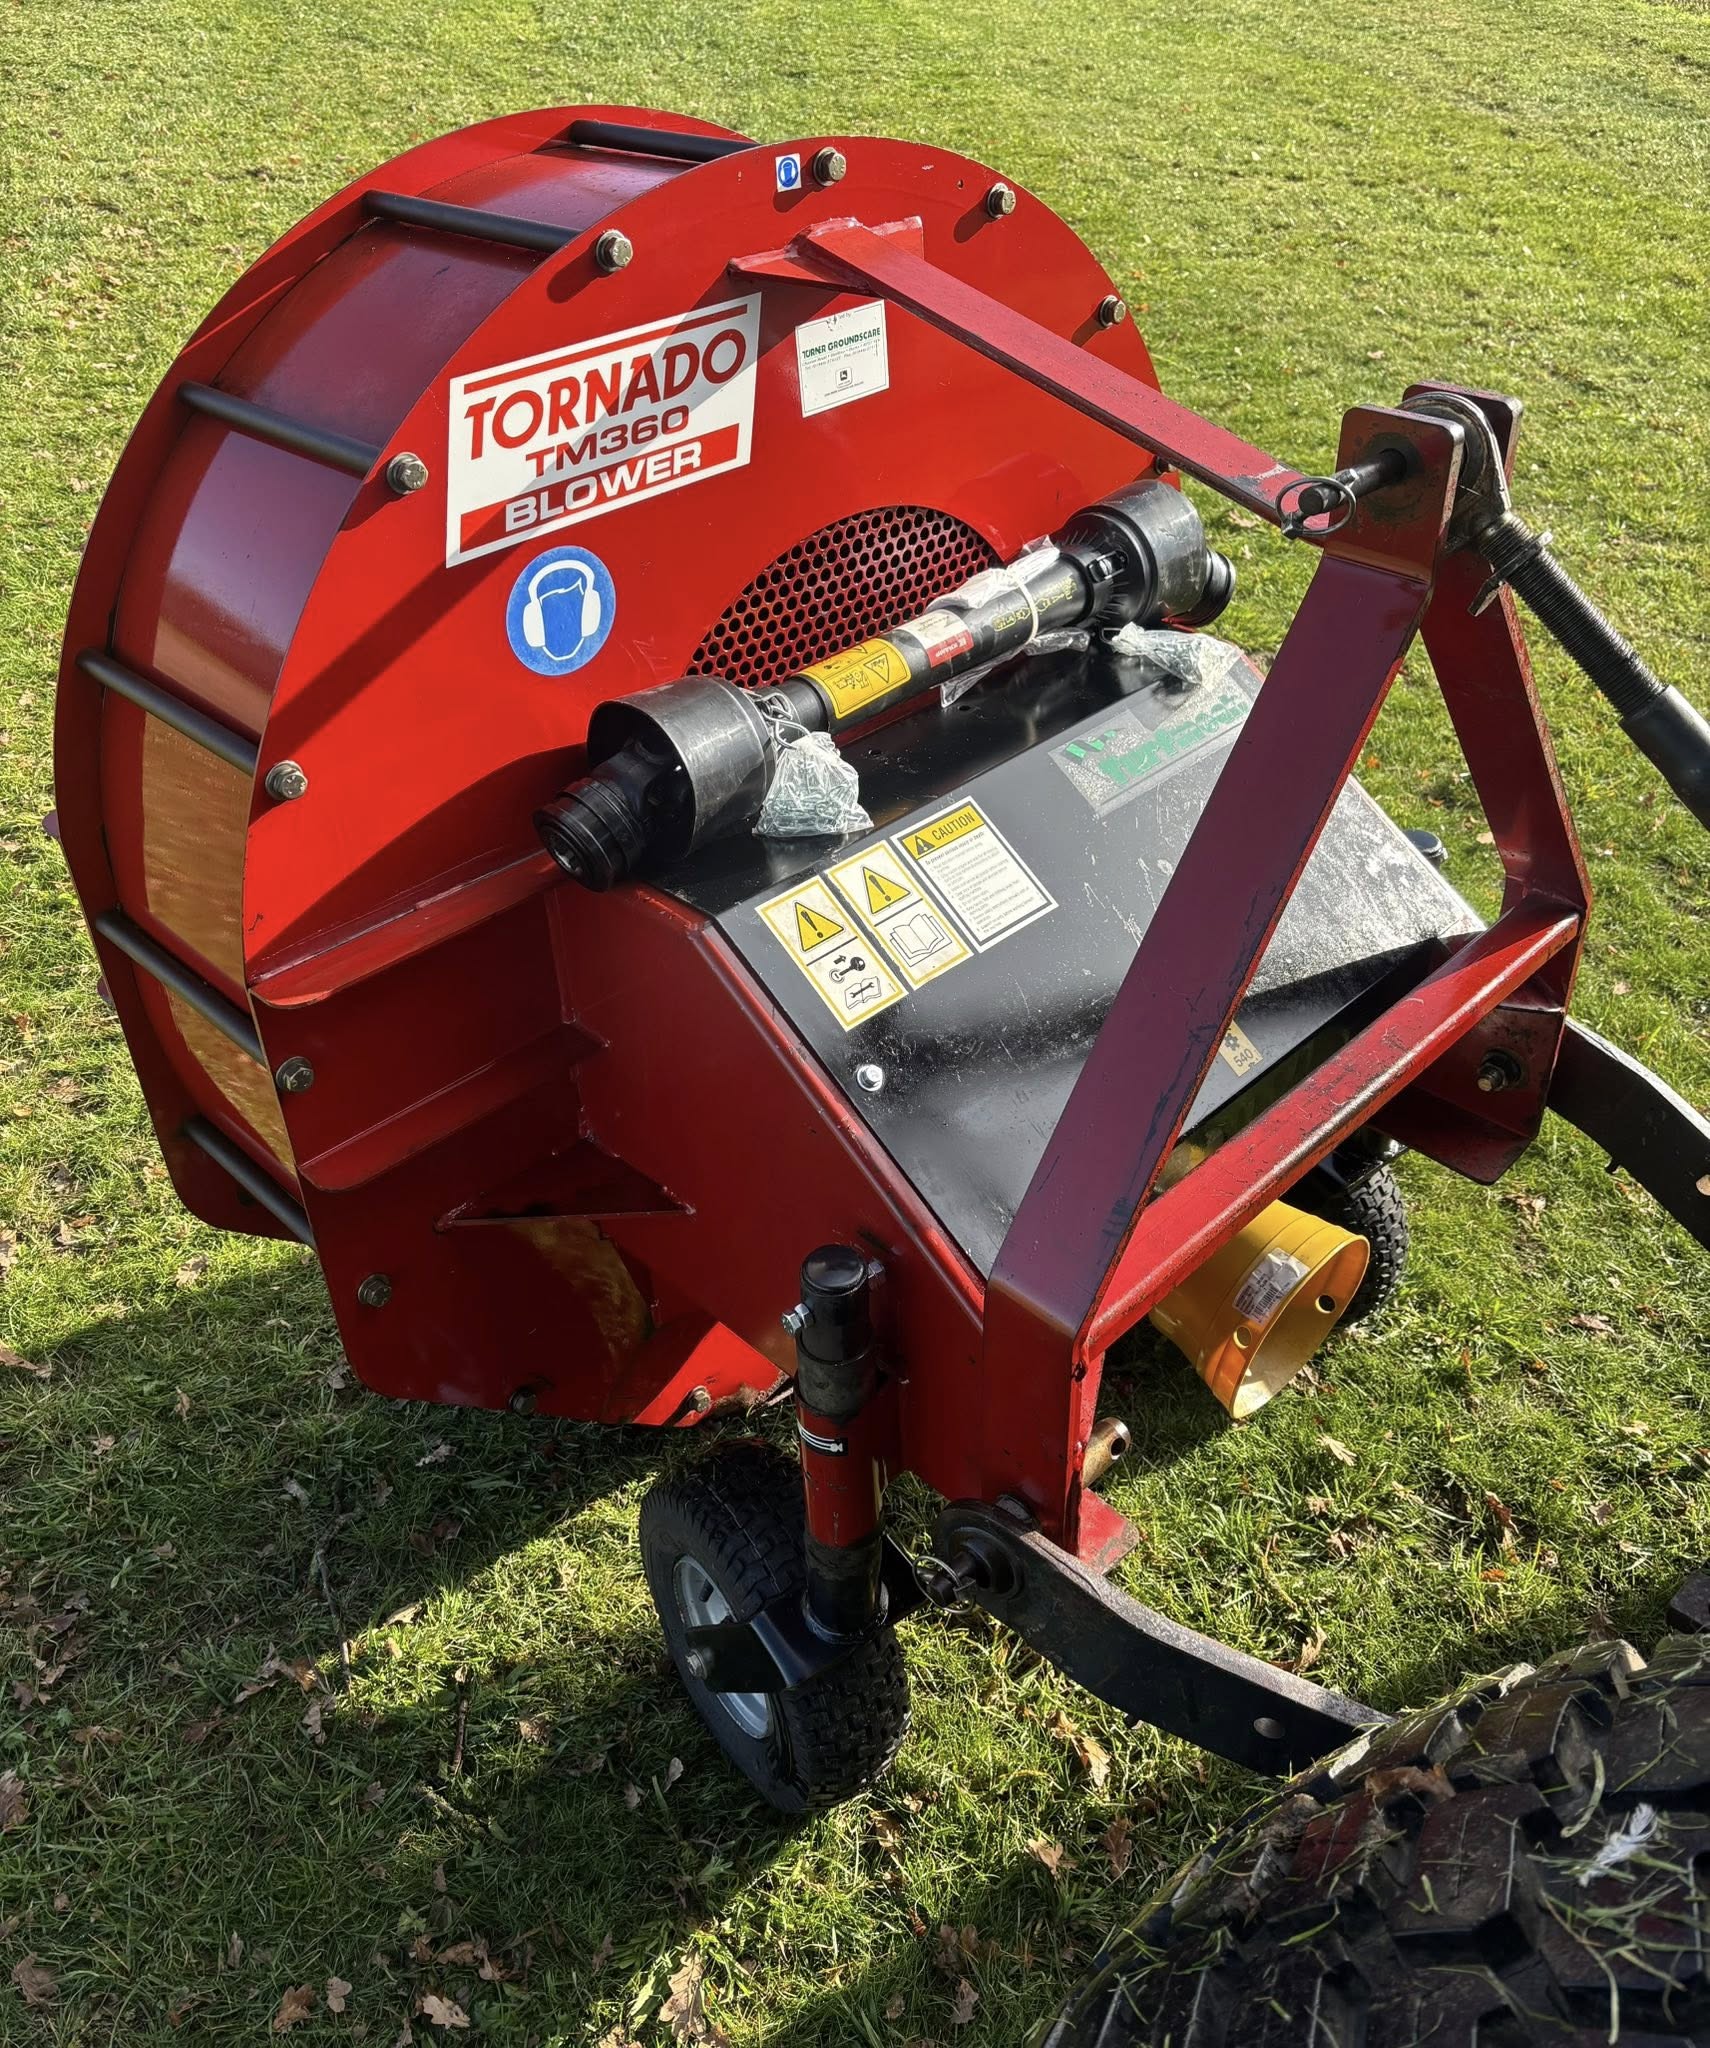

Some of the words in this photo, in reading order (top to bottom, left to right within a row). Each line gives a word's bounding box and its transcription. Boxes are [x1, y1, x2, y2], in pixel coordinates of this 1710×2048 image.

[802, 345, 826, 358] TURNER
[828, 327, 881, 351] GROUNDSCARE
[465, 329, 746, 460] TORNADO
[525, 404, 689, 478] TM360
[505, 441, 702, 532] BLOWER
[931, 812, 976, 841] CAUTION
[1233, 1048, 1254, 1067] 540
